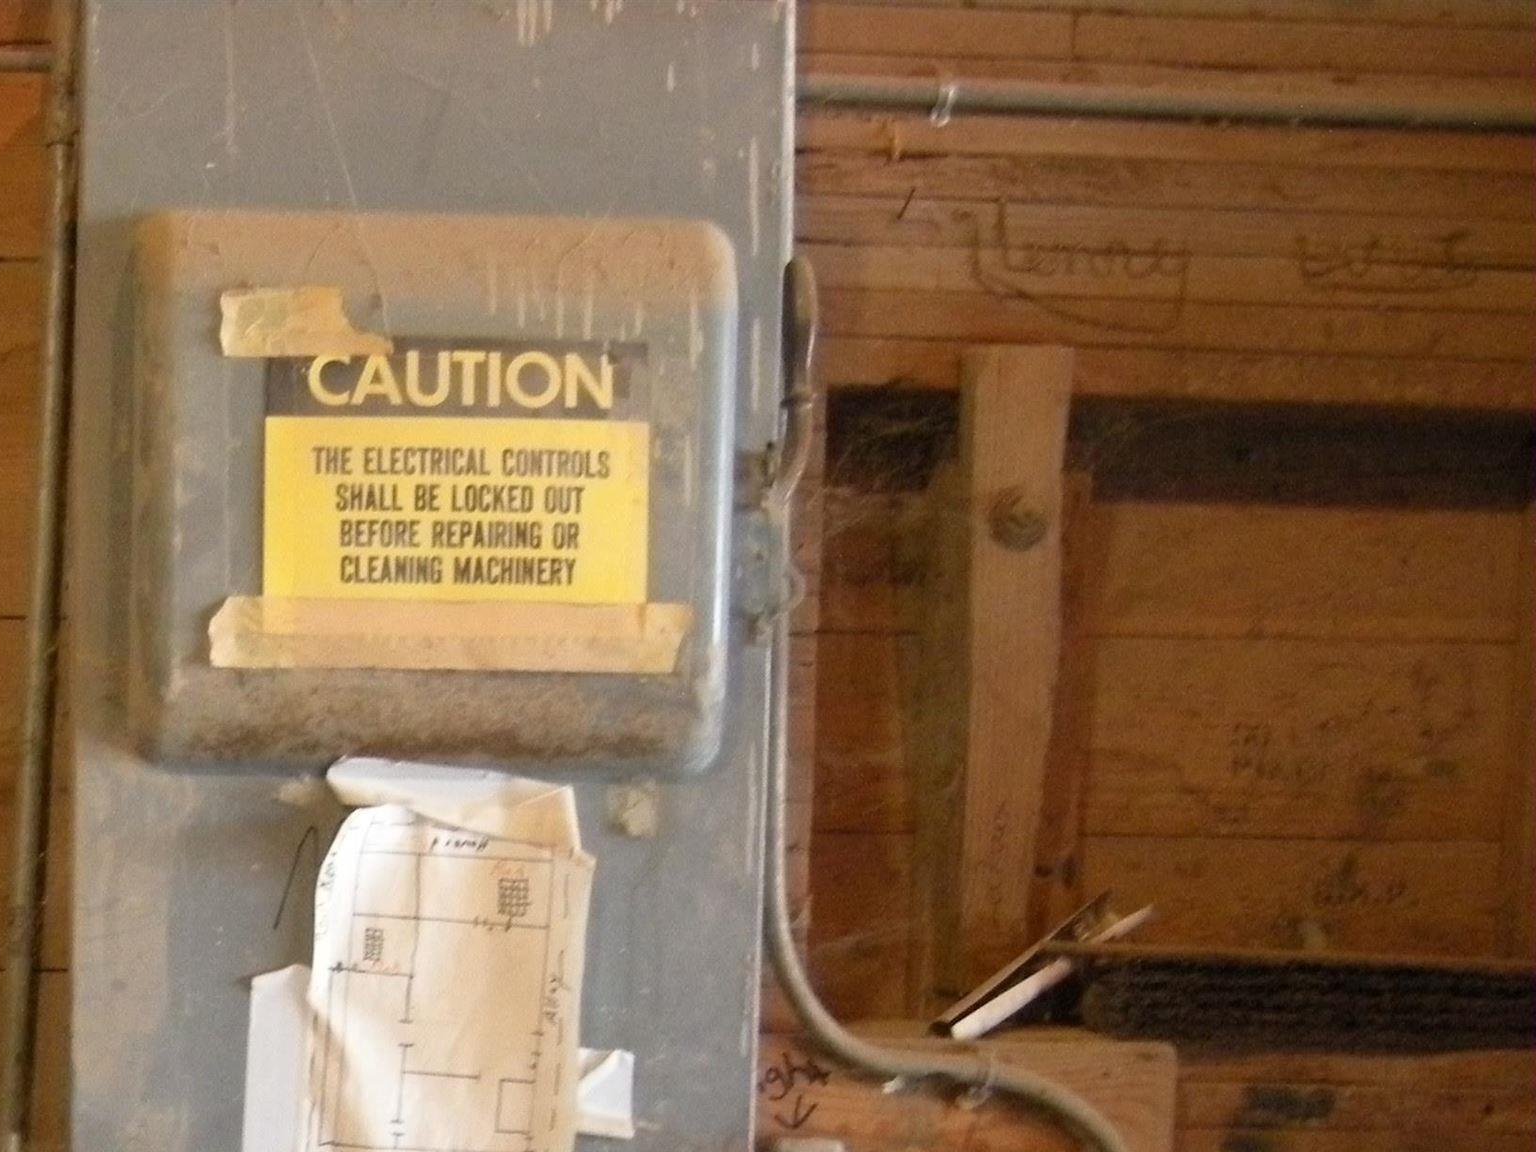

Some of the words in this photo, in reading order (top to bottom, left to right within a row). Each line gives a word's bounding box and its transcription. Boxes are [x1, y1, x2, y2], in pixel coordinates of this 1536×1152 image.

[308, 350, 614, 410] CAUTION
[312, 446, 353, 476] THE
[364, 447, 492, 477] ELECTRICAL
[501, 449, 611, 480] CONTROLS
[336, 483, 404, 512] SHALL
[414, 484, 440, 513] BE
[450, 485, 536, 514] LOCKED
[544, 486, 585, 515] OUT
[339, 519, 421, 549] BEFORE
[430, 520, 544, 550] REPAIRING
[552, 521, 581, 550] OR
[339, 556, 444, 585] CLEANING
[452, 557, 578, 587] MACHINERY
